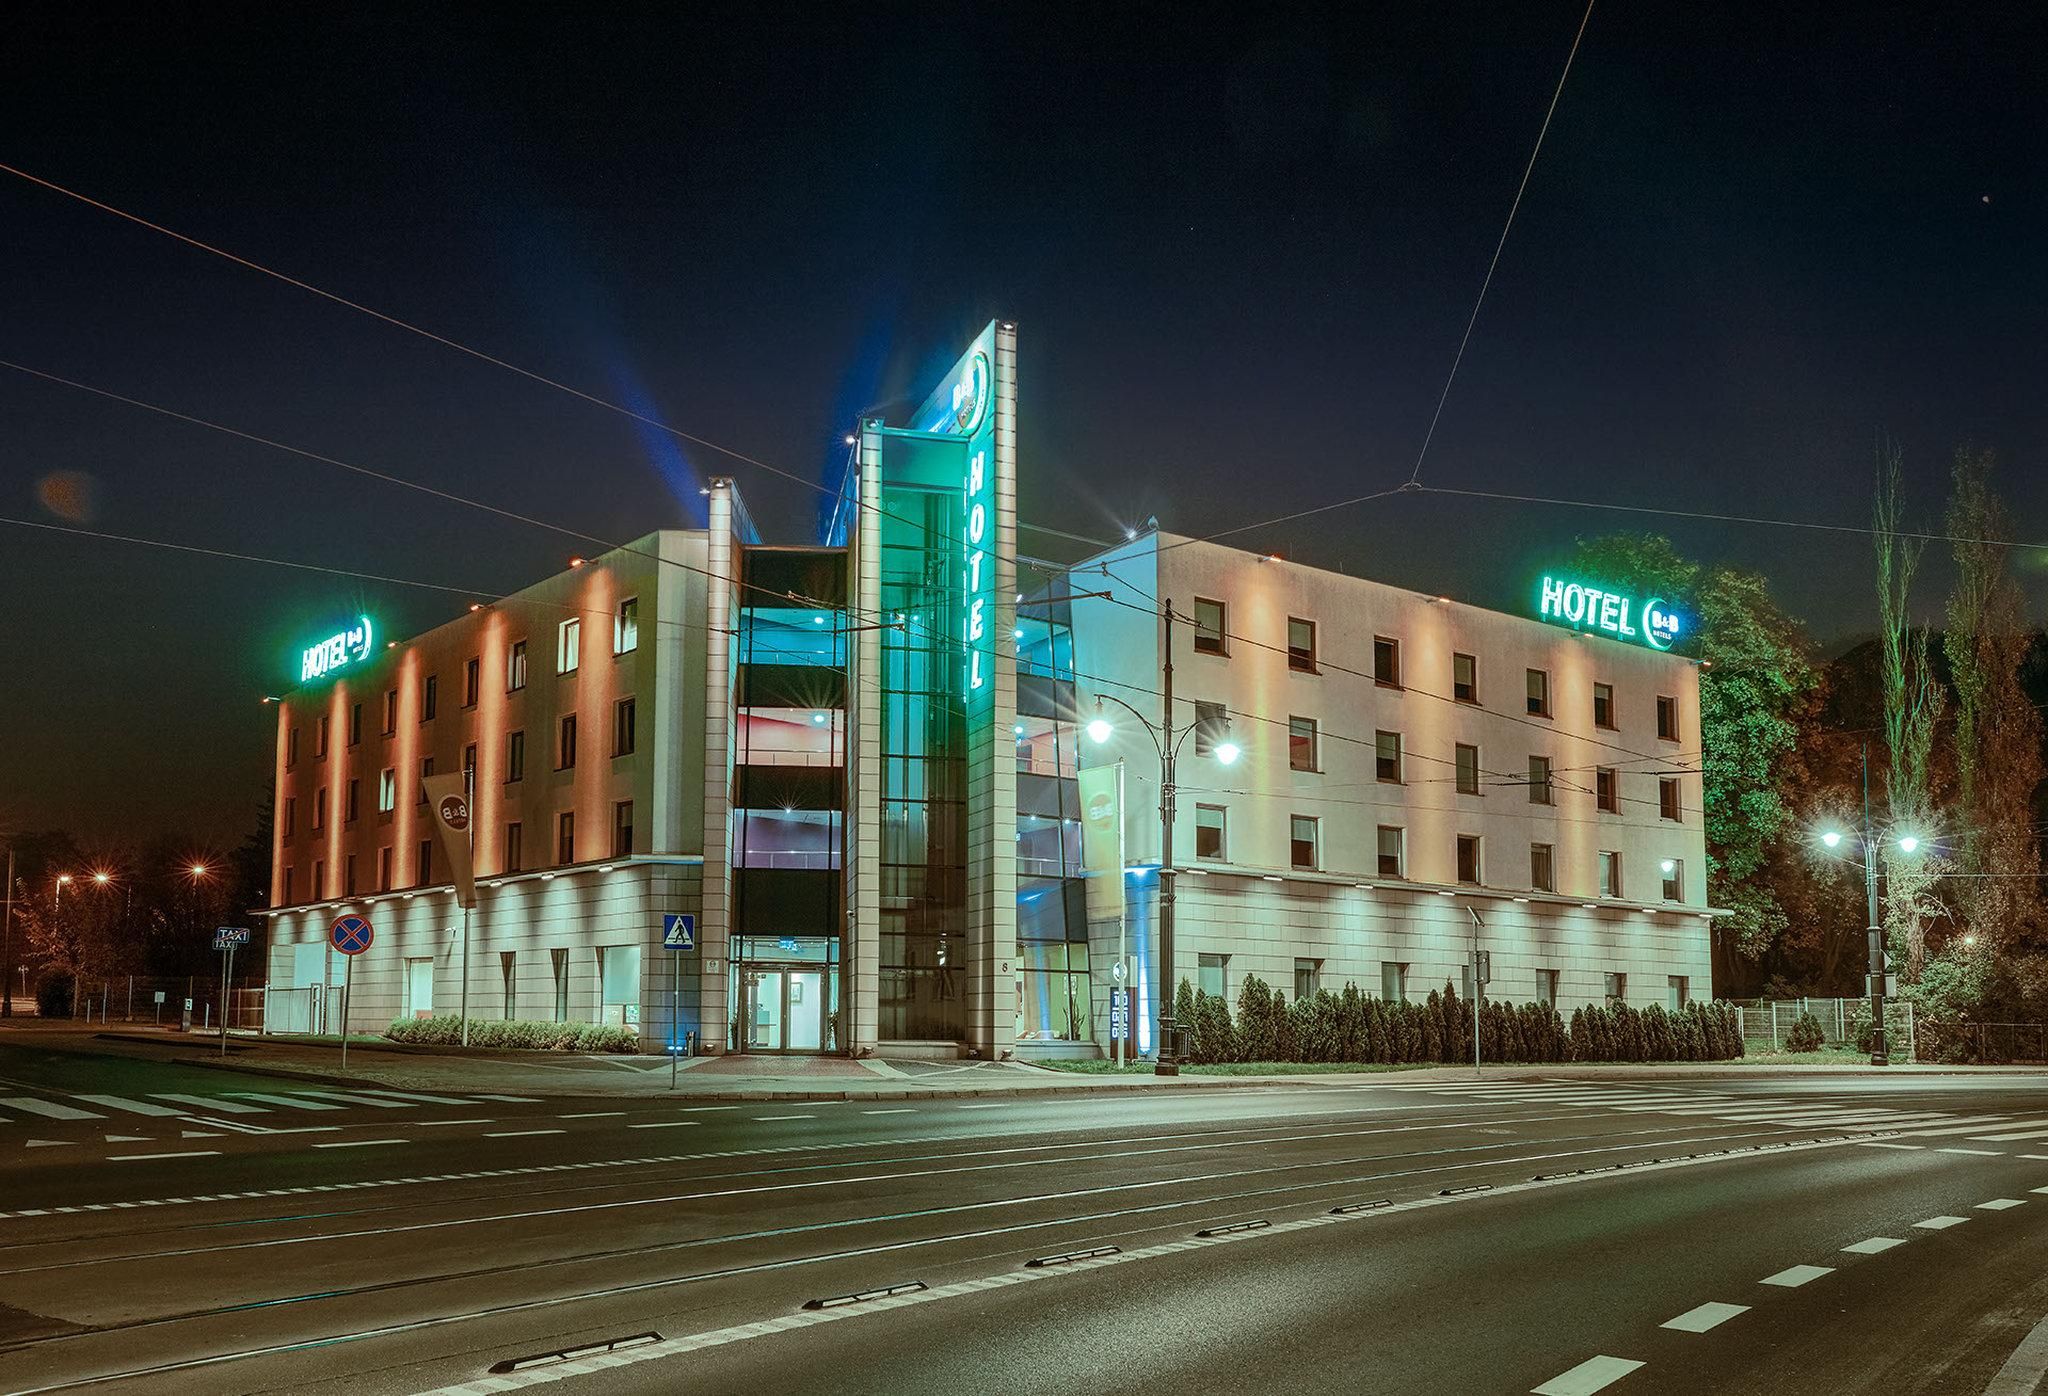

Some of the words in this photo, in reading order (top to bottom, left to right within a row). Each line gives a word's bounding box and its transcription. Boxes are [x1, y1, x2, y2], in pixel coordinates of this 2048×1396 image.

[969, 450, 985, 689] HOTEL
[1541, 577, 1635, 636] HOTEL
[1652, 610, 1679, 633] B&B
[301, 632, 348, 681] HOTEL
[219, 929, 247, 941] TAXI
